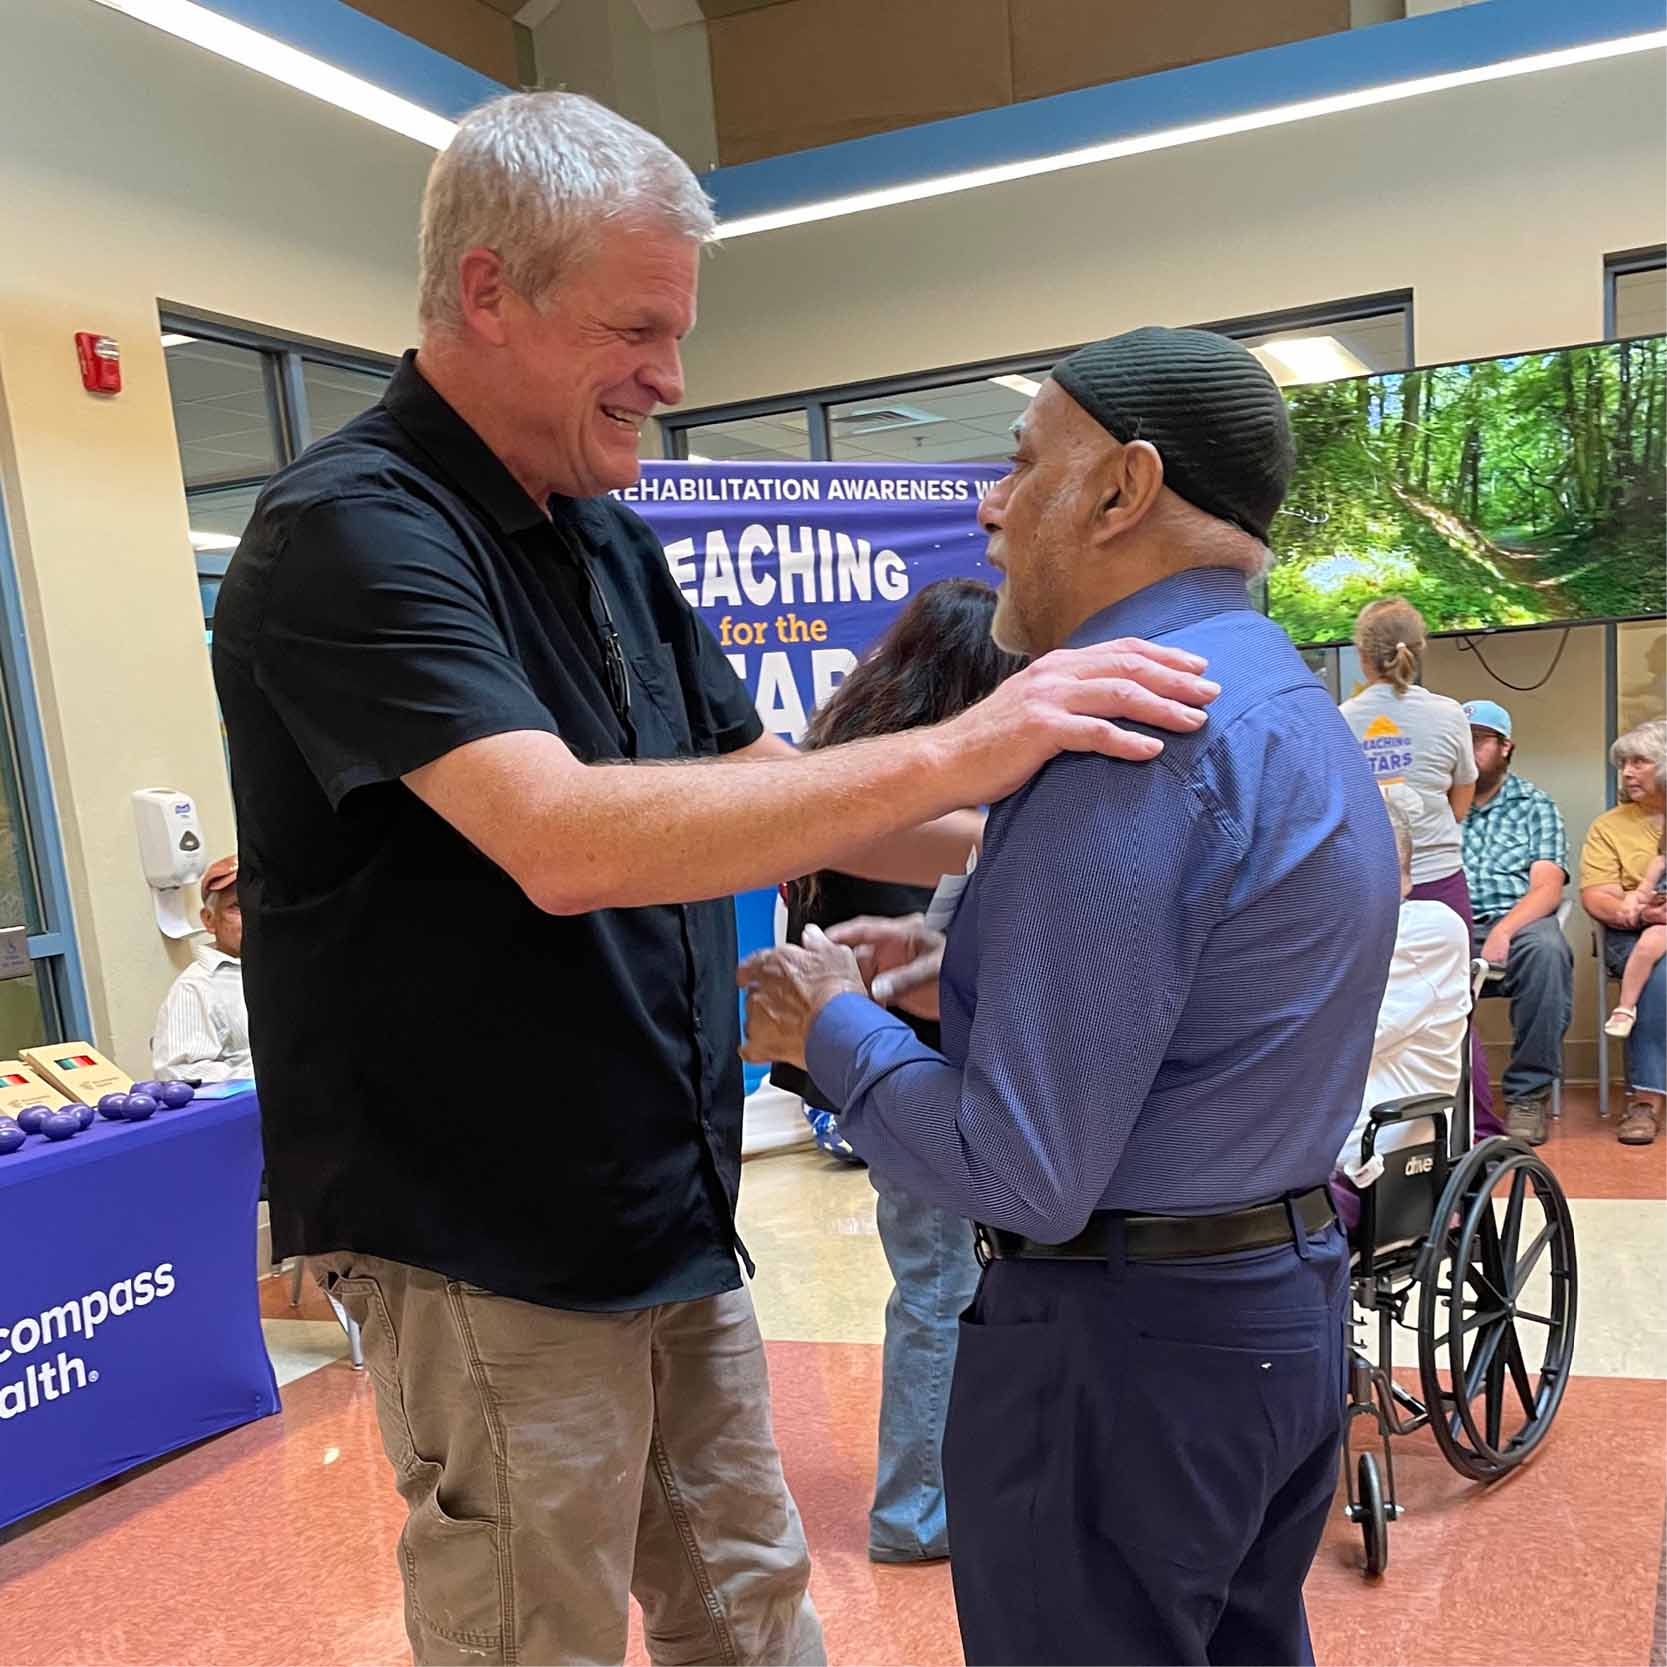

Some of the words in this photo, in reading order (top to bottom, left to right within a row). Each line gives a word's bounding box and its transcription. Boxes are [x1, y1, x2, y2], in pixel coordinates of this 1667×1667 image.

[827, 479, 969, 500] AWARENESS
[974, 480, 1000, 500] W
[719, 616, 768, 646] for
[775, 613, 828, 643] the
